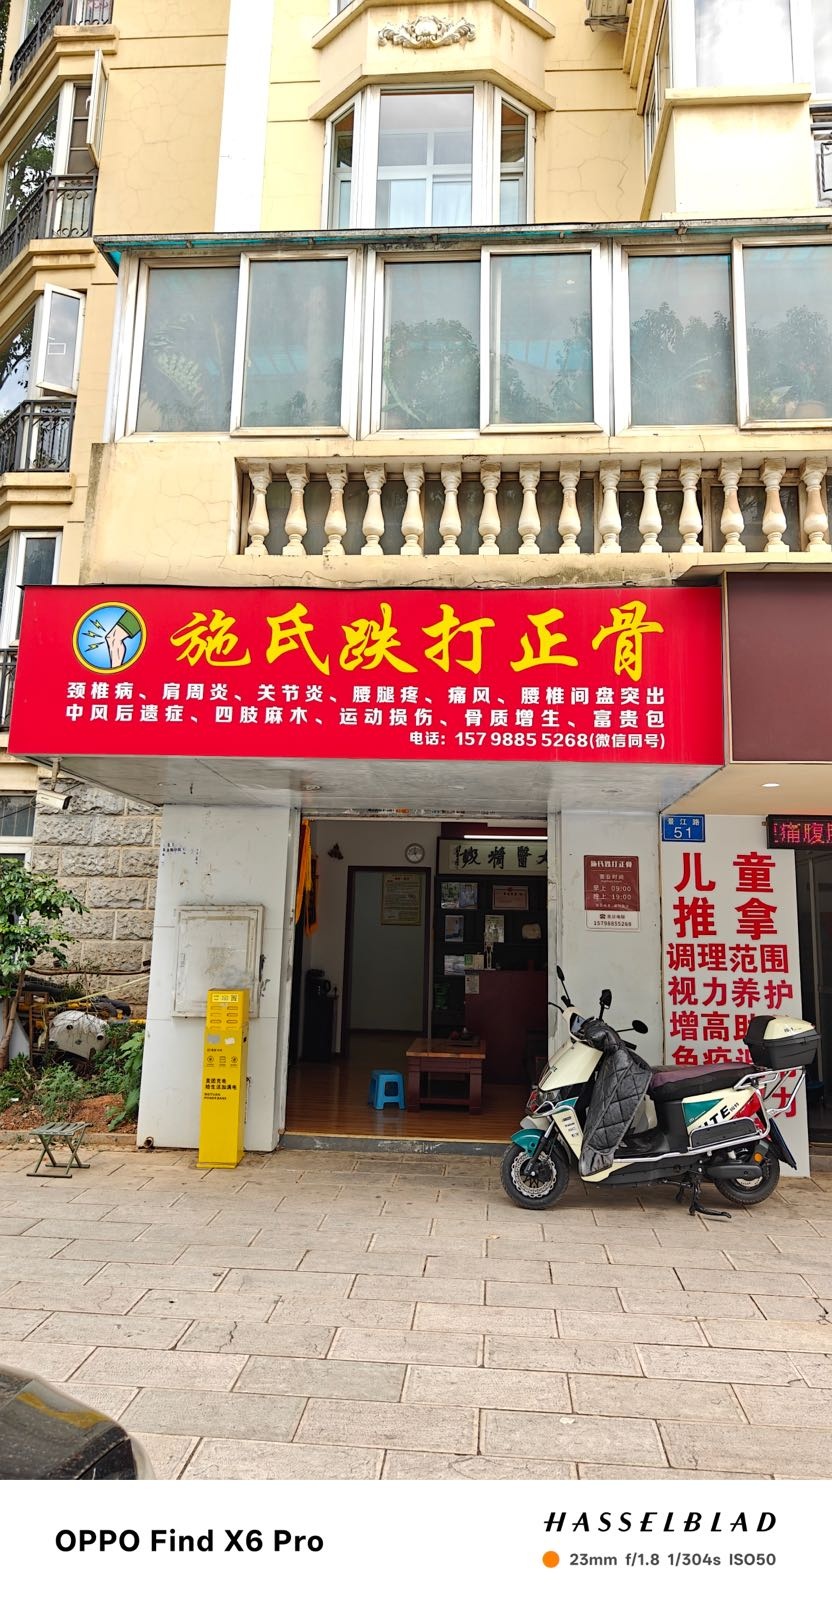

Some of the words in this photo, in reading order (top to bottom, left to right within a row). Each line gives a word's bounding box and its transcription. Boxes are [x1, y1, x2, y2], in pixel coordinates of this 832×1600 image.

[170, 600, 664, 682] 施氏跌打正骨
[66, 682, 665, 706] 颈椎病、肩周炎、关节炎、腰腿疼、痛风、腰椎间盘突出
[66, 704, 665, 728] 中风后遗症、四肢麻木、运动损伤、骨质增生、富贵包
[455, 732, 487, 746] 157
[490, 732, 537, 747] 9885
[674, 826, 691, 839] 51
[674, 850, 777, 894] 儿童
[672, 896, 778, 941] 推拿
[666, 942, 790, 975] 调理范围
[668, 976, 794, 1009] 视力养护
